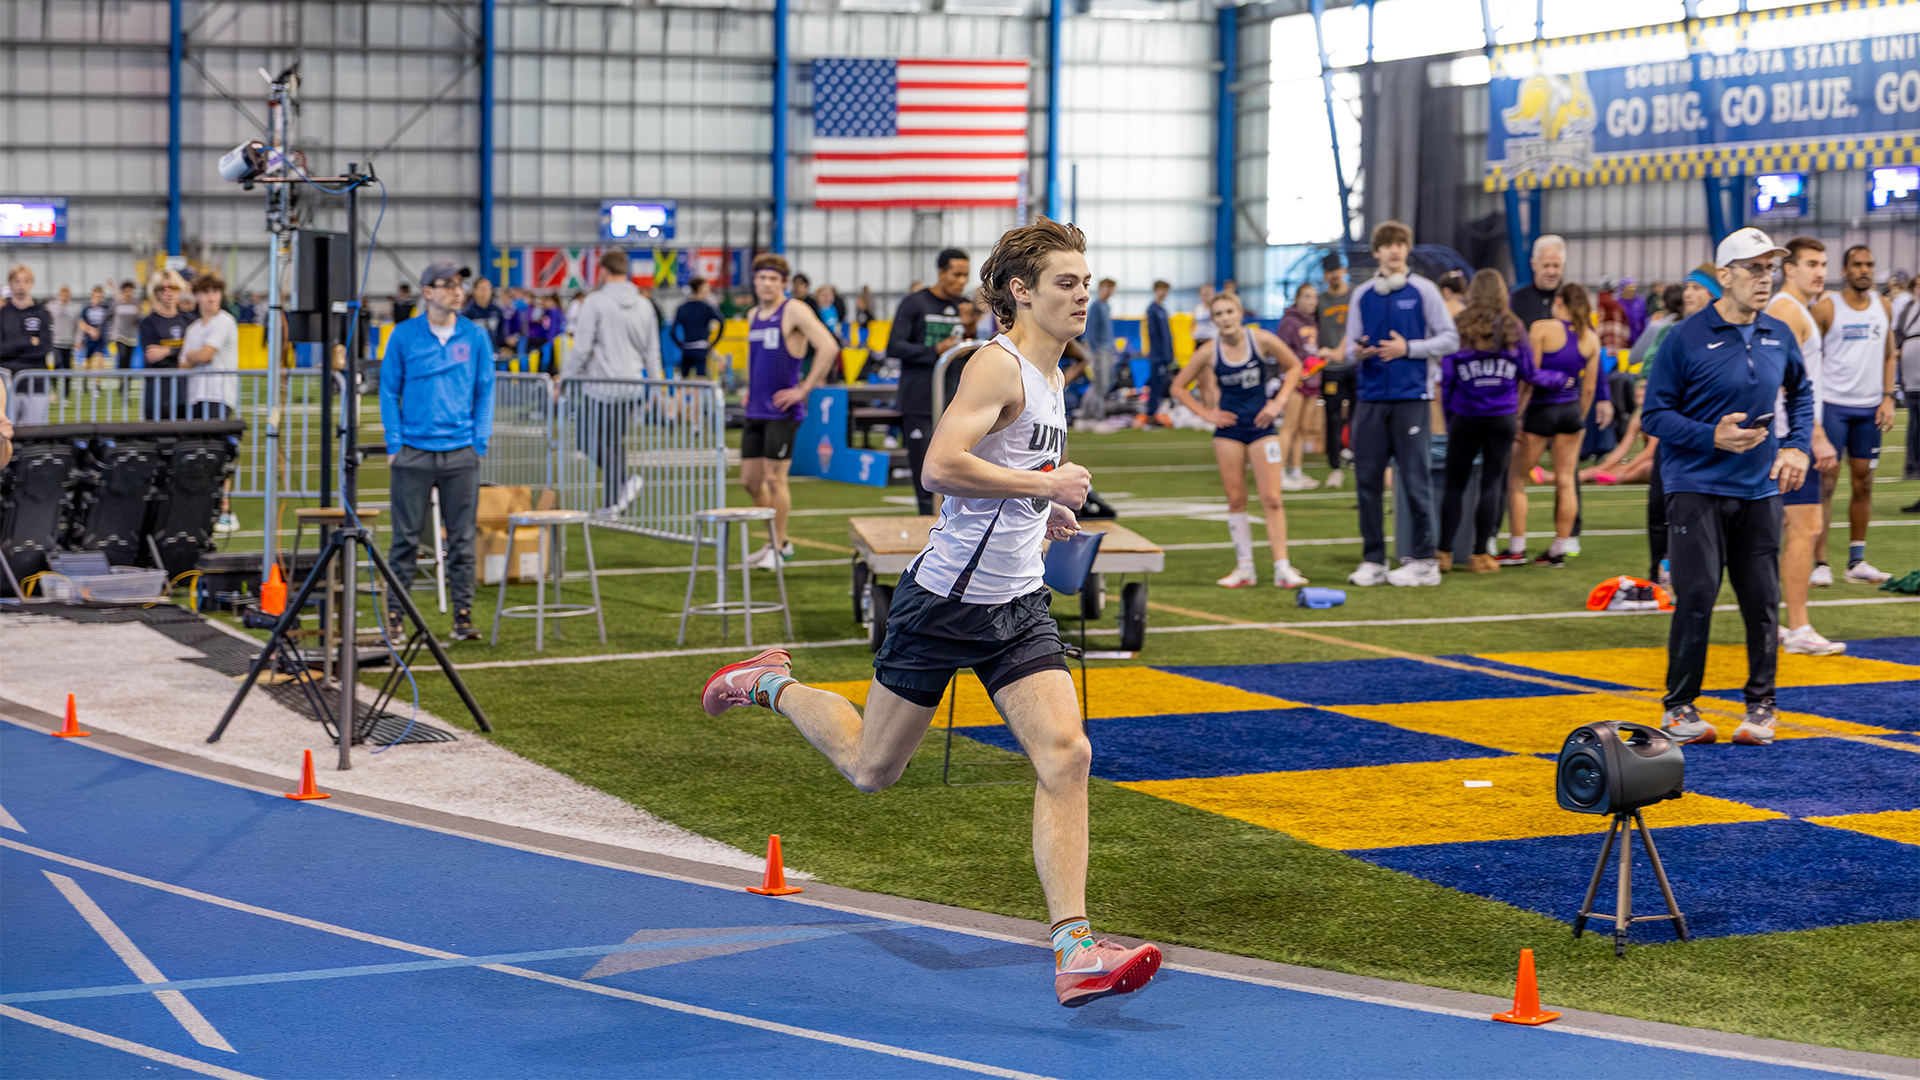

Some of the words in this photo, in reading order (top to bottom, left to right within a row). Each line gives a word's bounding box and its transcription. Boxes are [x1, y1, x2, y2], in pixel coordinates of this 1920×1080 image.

[1625, 59, 1693, 90] SOUTH
[1699, 48, 1786, 81] DAKOTA
[1792, 39, 1862, 71] STATE
[1871, 32, 1920, 63] UNI
[1606, 96, 1647, 138] GO
[1651, 91, 1708, 135] BIG.
[1721, 84, 1766, 128] GO
[1771, 76, 1859, 124] BLUE.
[1874, 69, 1920, 115] GO
[1457, 358, 1517, 381] BRUIN
[820, 396, 834, 424] 1
